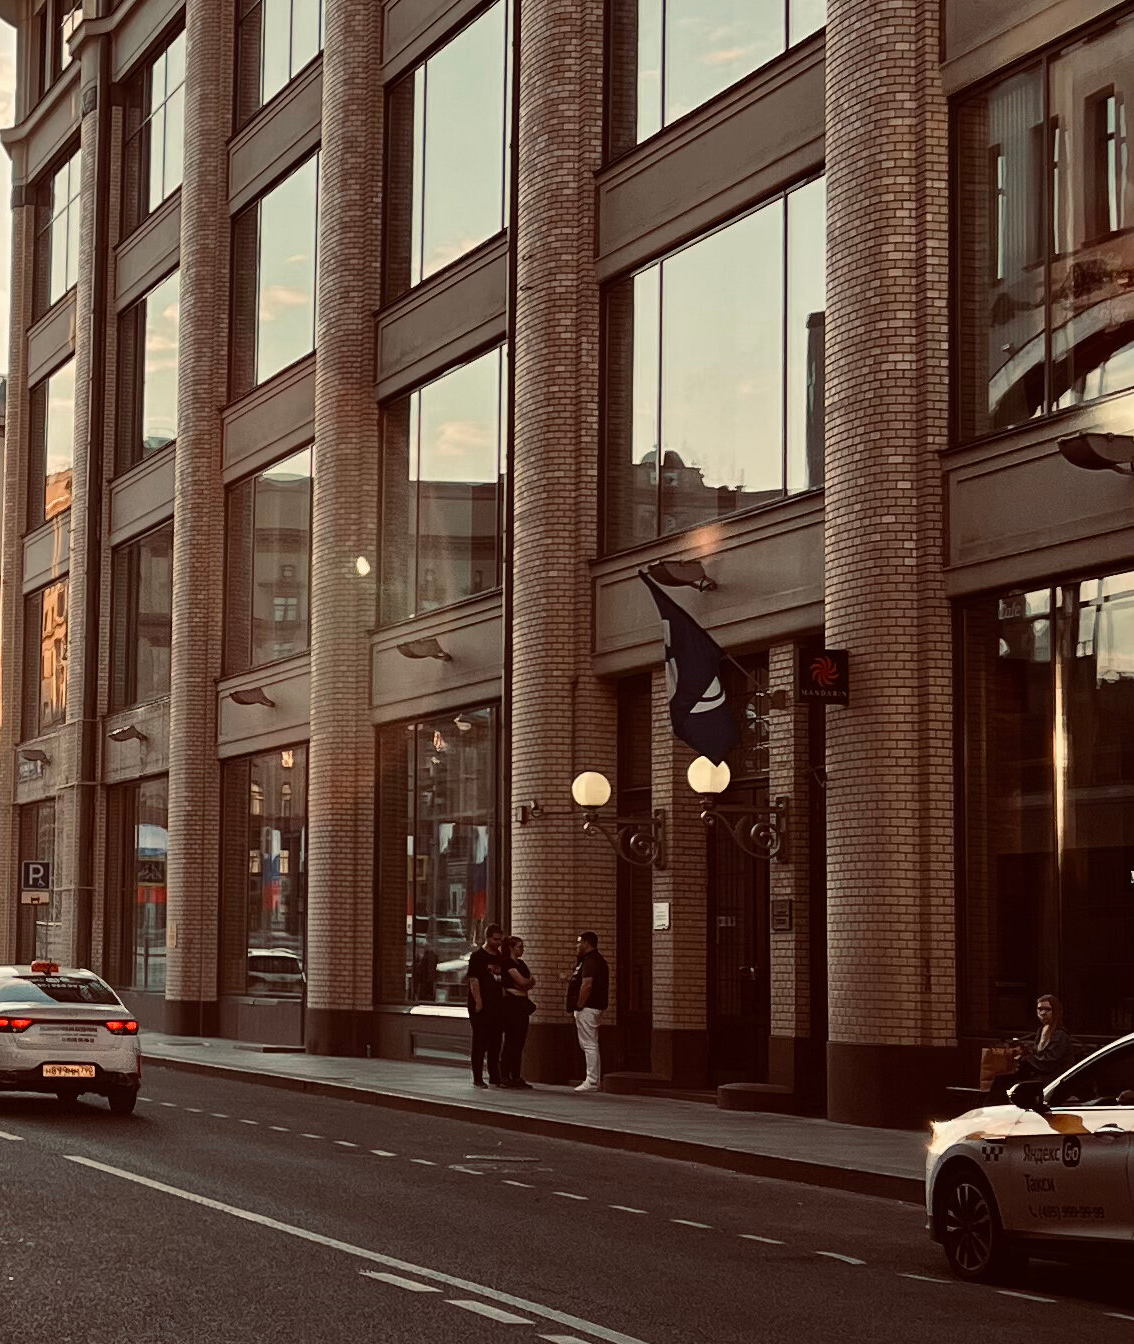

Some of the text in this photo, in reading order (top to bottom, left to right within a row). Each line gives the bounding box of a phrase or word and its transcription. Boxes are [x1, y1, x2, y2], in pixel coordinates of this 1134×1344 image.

[801, 688, 847, 697] MANDARIN
[29, 864, 44, 885] P
[1022, 1142, 1079, 1164] Яндекс Go
[1024, 1174, 1055, 1192] Такси
